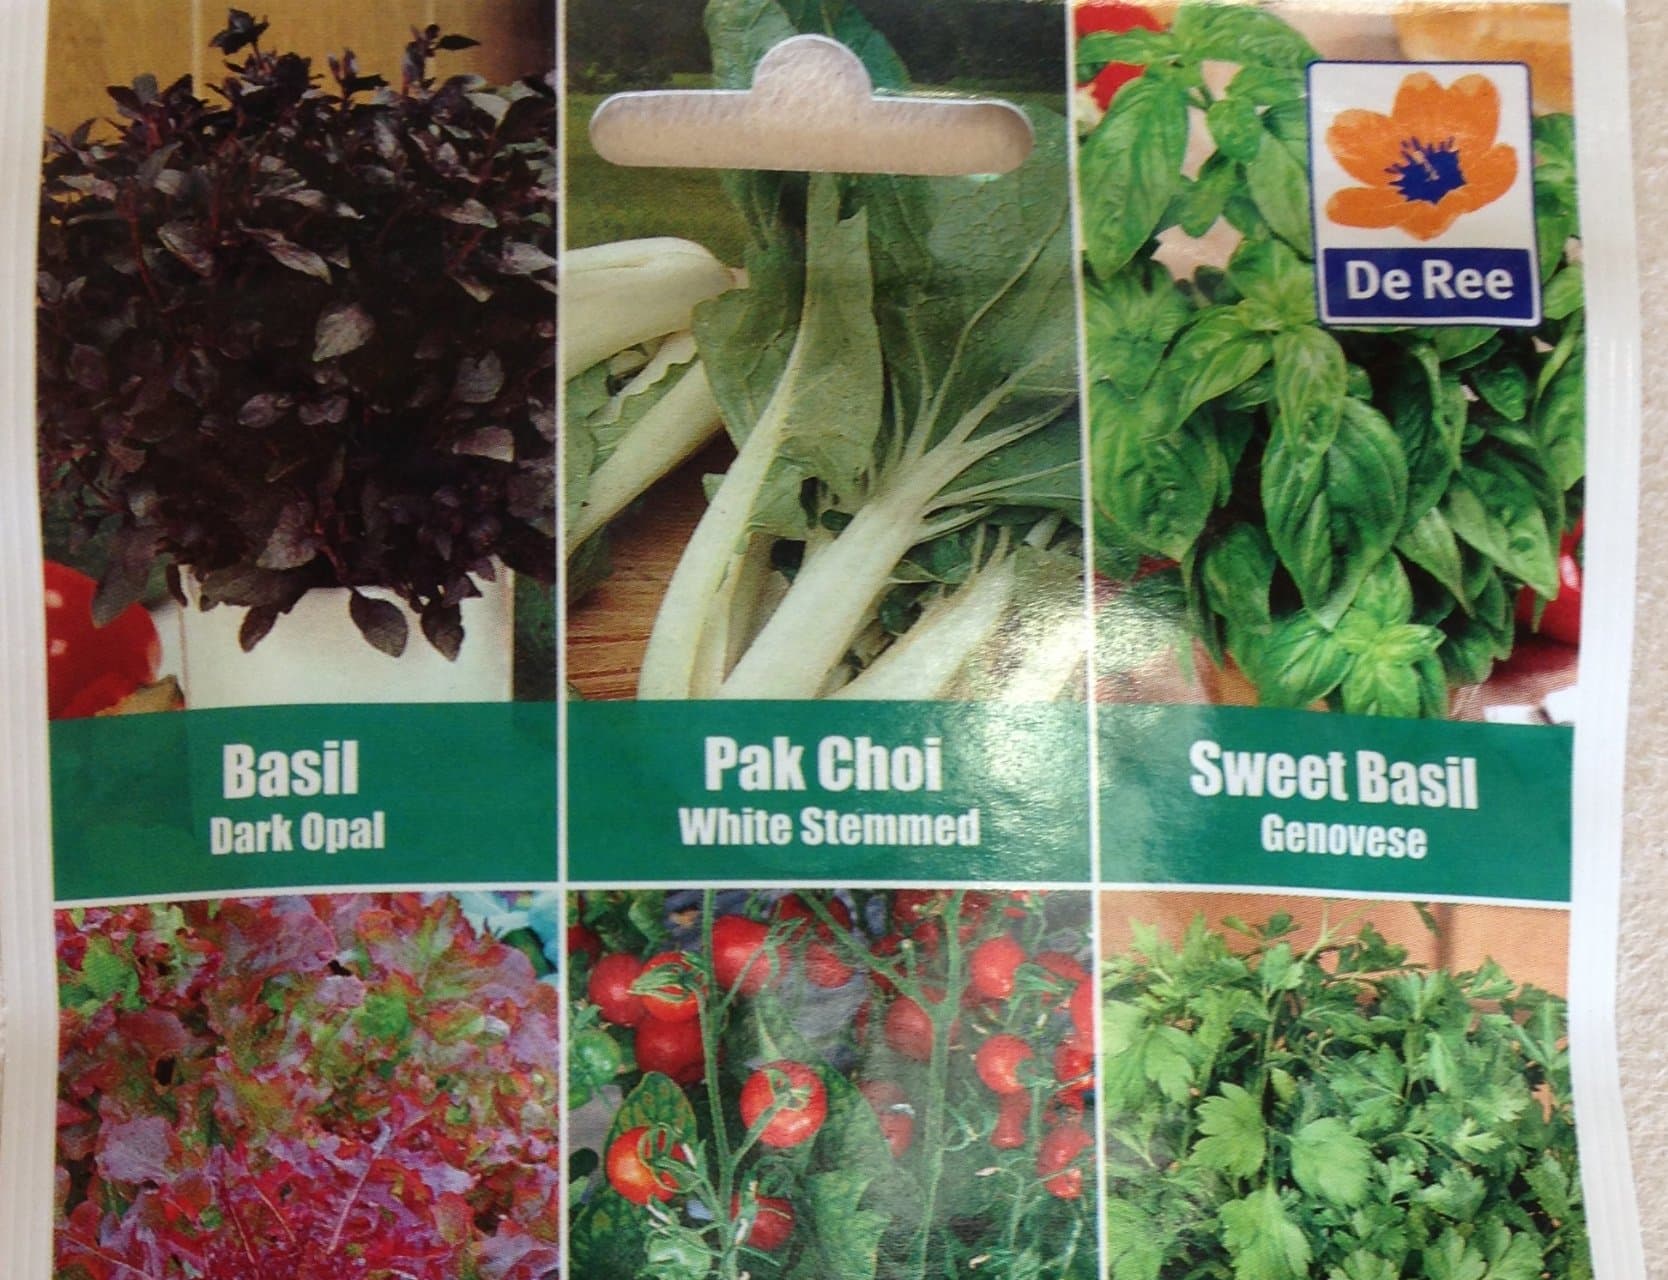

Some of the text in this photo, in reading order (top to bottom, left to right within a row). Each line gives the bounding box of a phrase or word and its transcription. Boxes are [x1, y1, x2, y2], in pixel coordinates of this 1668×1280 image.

[1345, 258, 1514, 301] De Ree
[222, 740, 359, 799] Basil
[705, 735, 943, 792] Pak Choi
[1189, 740, 1479, 809] Sweet Basil
[210, 810, 385, 855] Dark Opal
[678, 806, 980, 846] White Stemmed
[1260, 813, 1428, 859] Genovese
